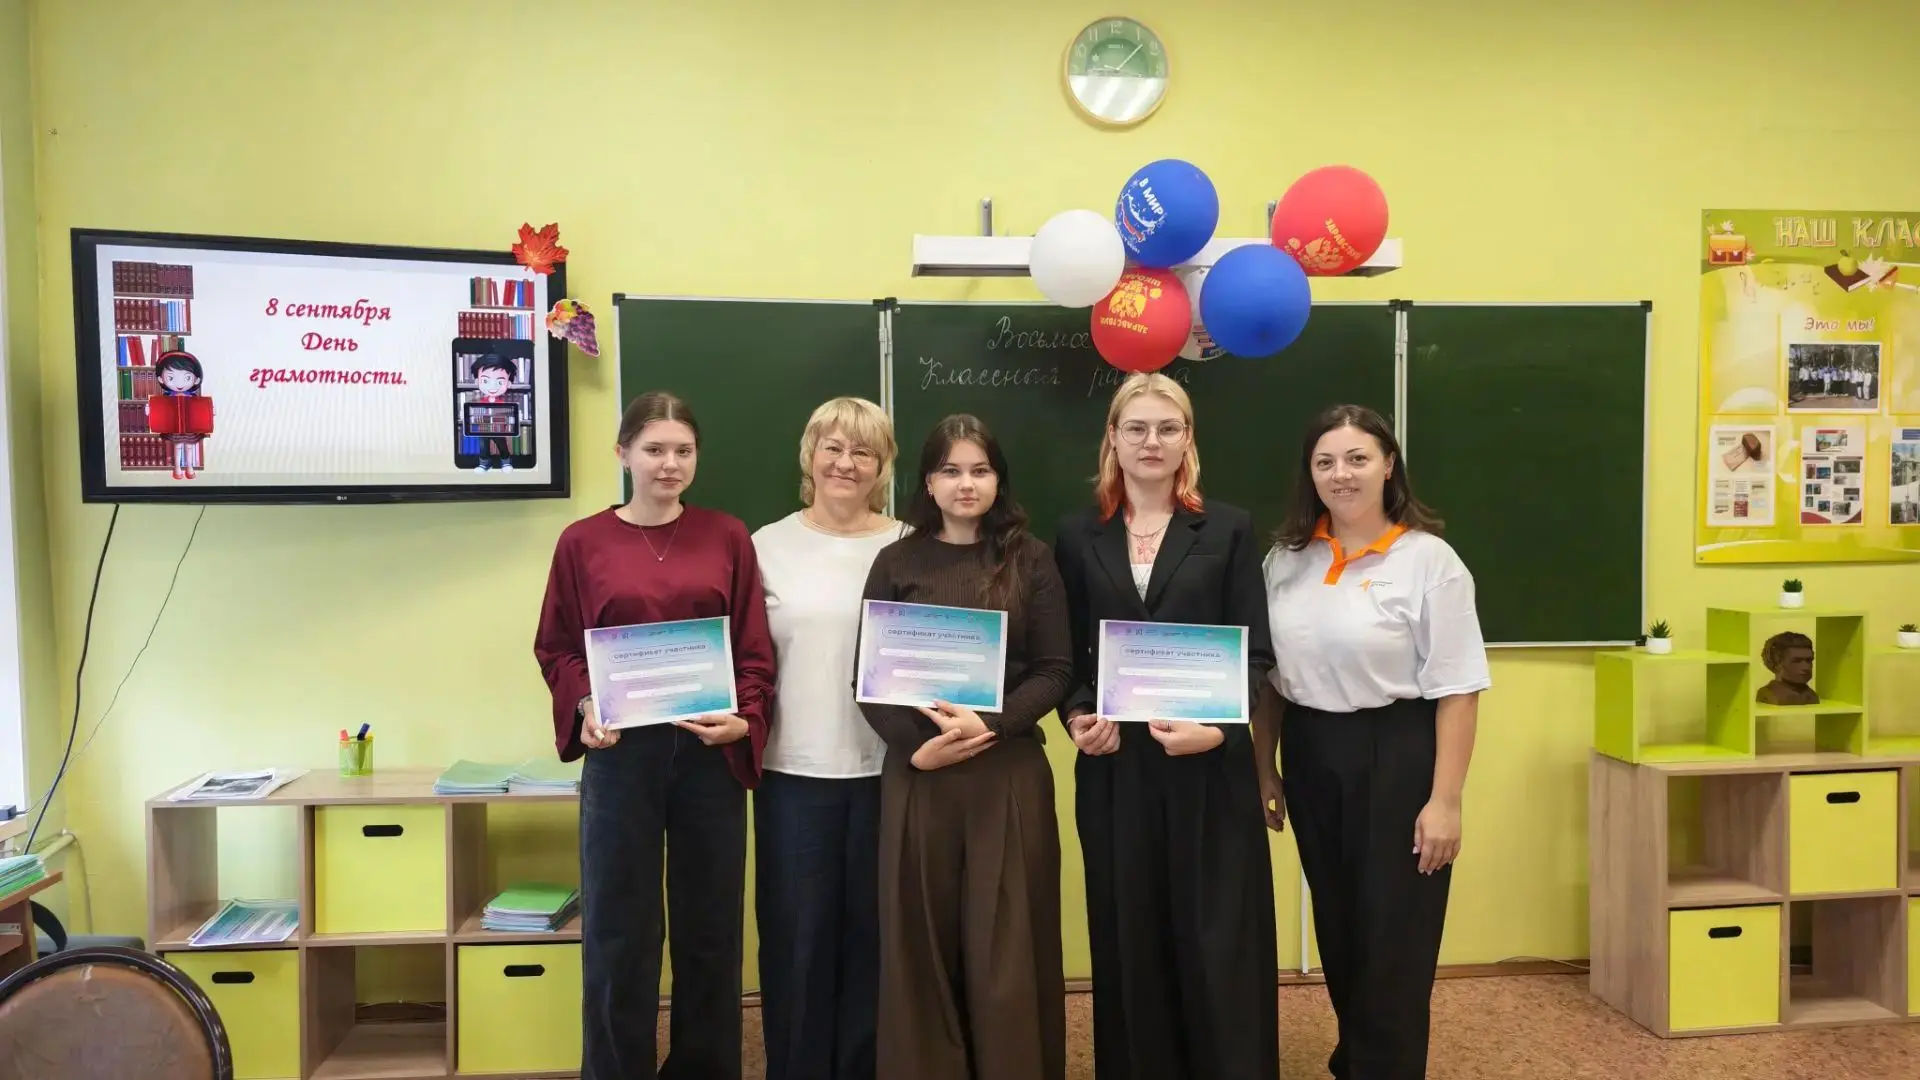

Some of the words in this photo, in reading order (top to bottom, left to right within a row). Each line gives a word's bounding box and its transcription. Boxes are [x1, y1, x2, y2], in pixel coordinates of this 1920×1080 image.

[1139, 177, 1149, 187] В
[1142, 187, 1164, 216] МИР
[1774, 216, 1837, 248] НАШ
[265, 298, 279, 316] 8
[285, 299, 392, 326] сентября
[1804, 317, 1839, 331] Это
[301, 332, 358, 352] День
[249, 368, 407, 389] грамотности.
[888, 628, 936, 639] сертификат
[614, 649, 662, 660] сертификат
